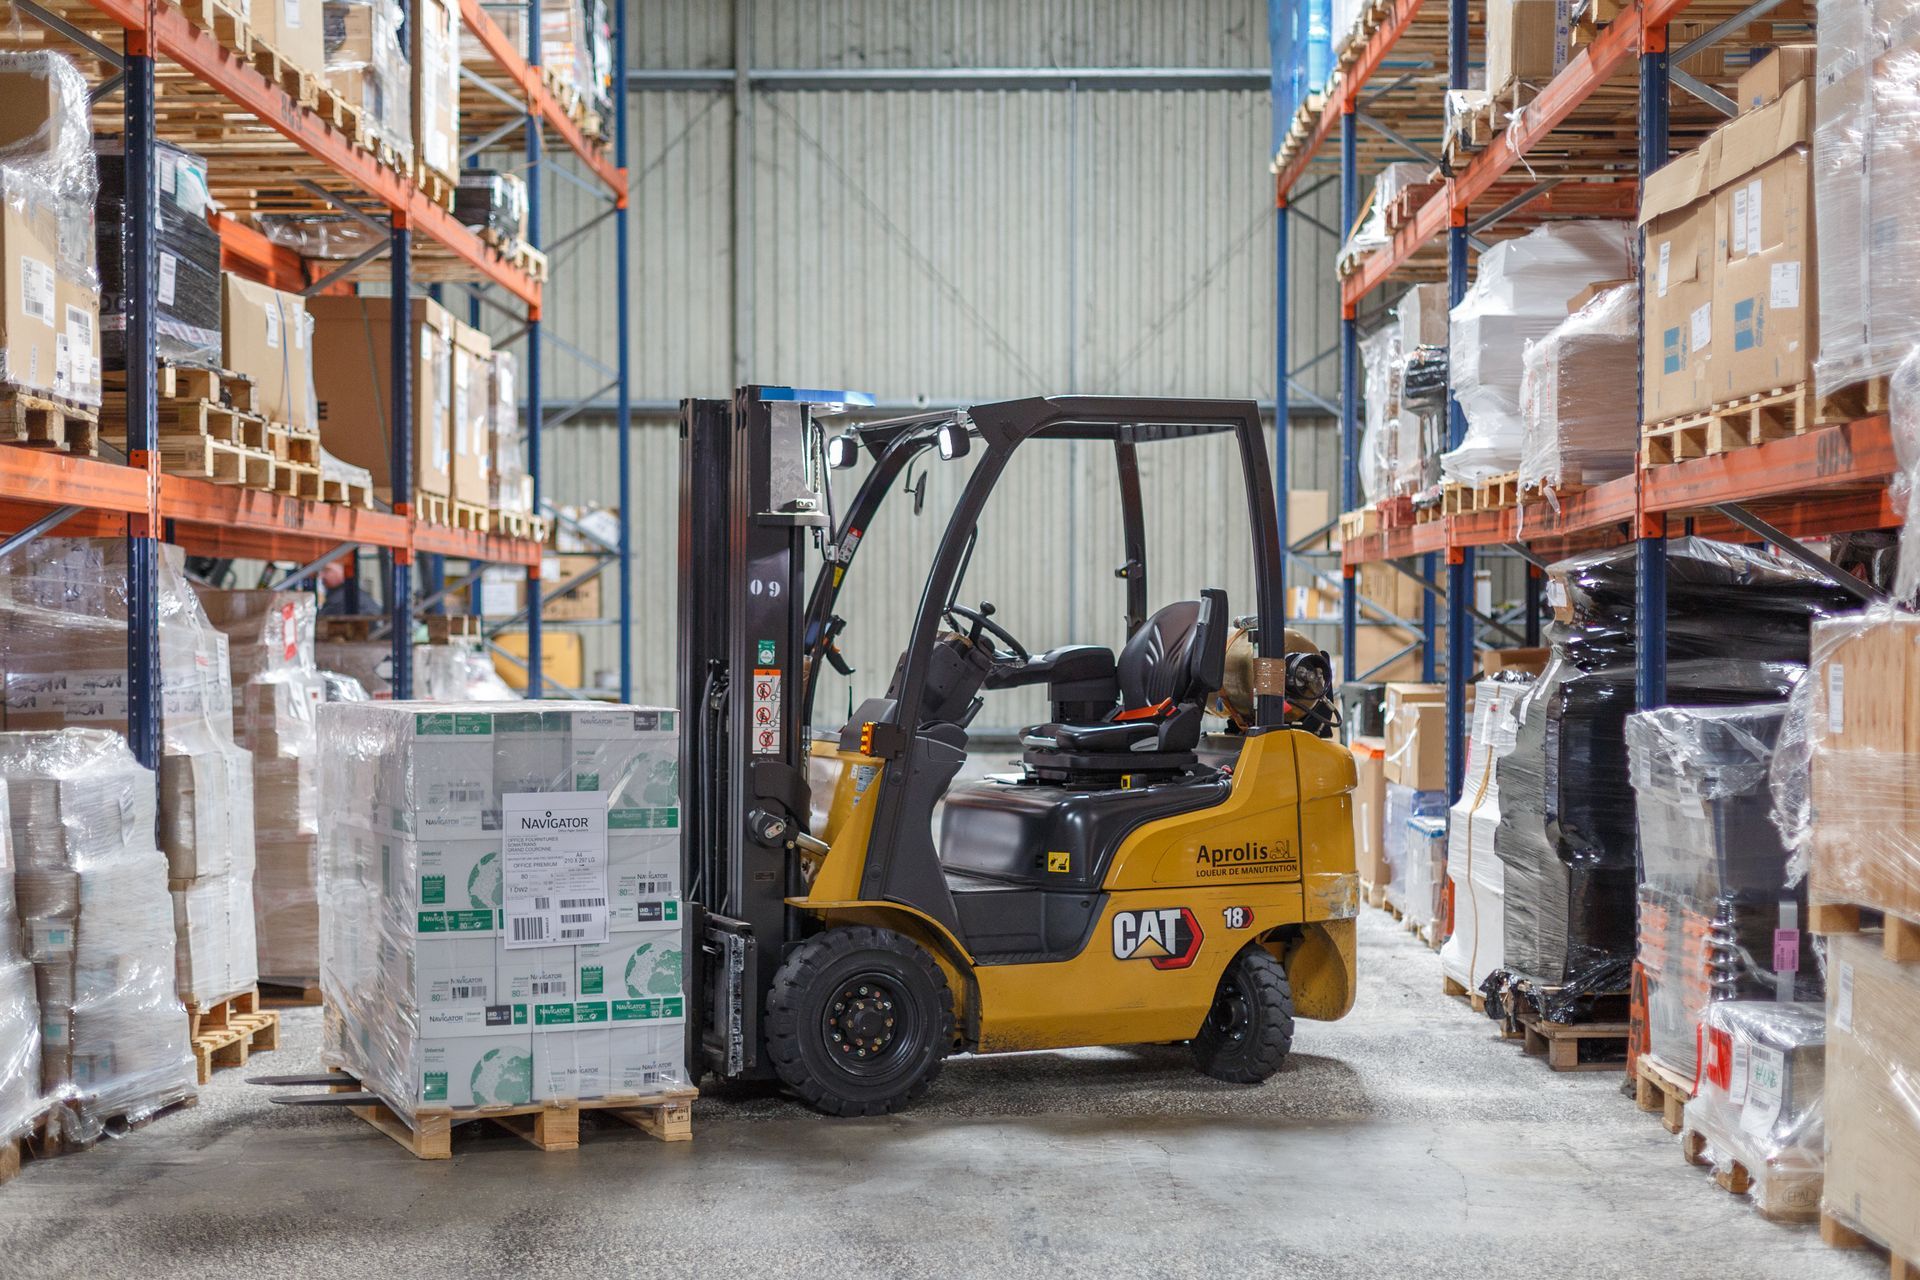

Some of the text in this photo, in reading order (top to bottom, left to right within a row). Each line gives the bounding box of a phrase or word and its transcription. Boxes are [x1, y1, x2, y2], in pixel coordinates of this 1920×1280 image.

[521, 817, 589, 829] NAVIGATOR
[1197, 843, 1268, 867] Aprolis
[1196, 864, 1297, 877] LOUEUR DE MANUTENTION
[1223, 907, 1244, 928] 18
[1114, 909, 1181, 958] CAT
[432, 993, 441, 1001] 80
